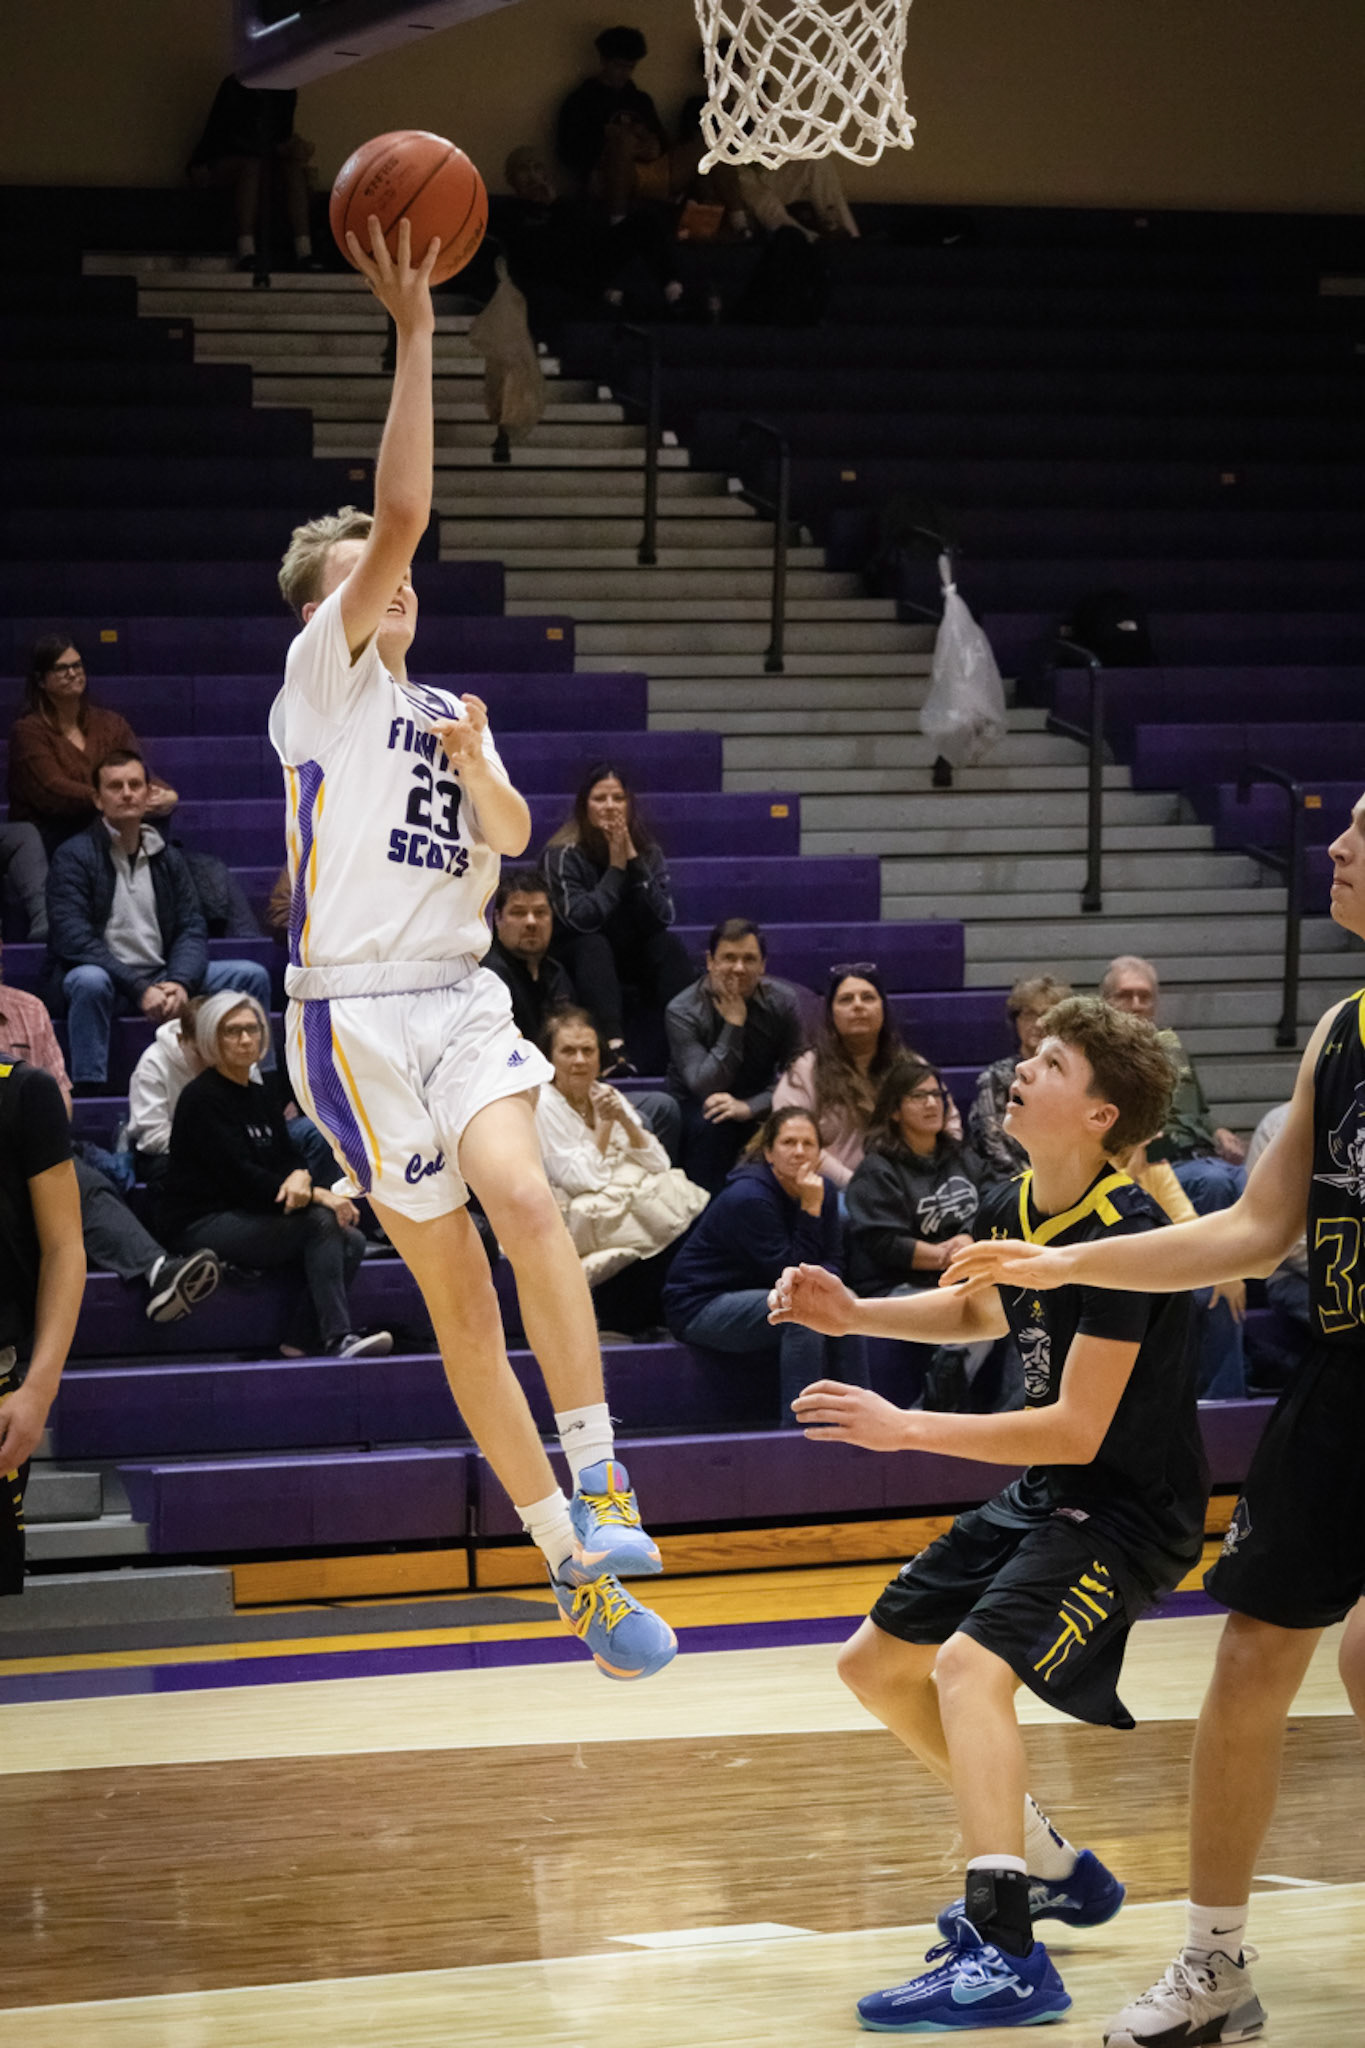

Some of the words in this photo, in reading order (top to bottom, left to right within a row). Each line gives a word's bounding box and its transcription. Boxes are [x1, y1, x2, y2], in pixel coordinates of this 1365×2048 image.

[405, 763, 462, 841] 23
[387, 828, 469, 878] SCOTS
[1314, 1216, 1365, 1334] 3
